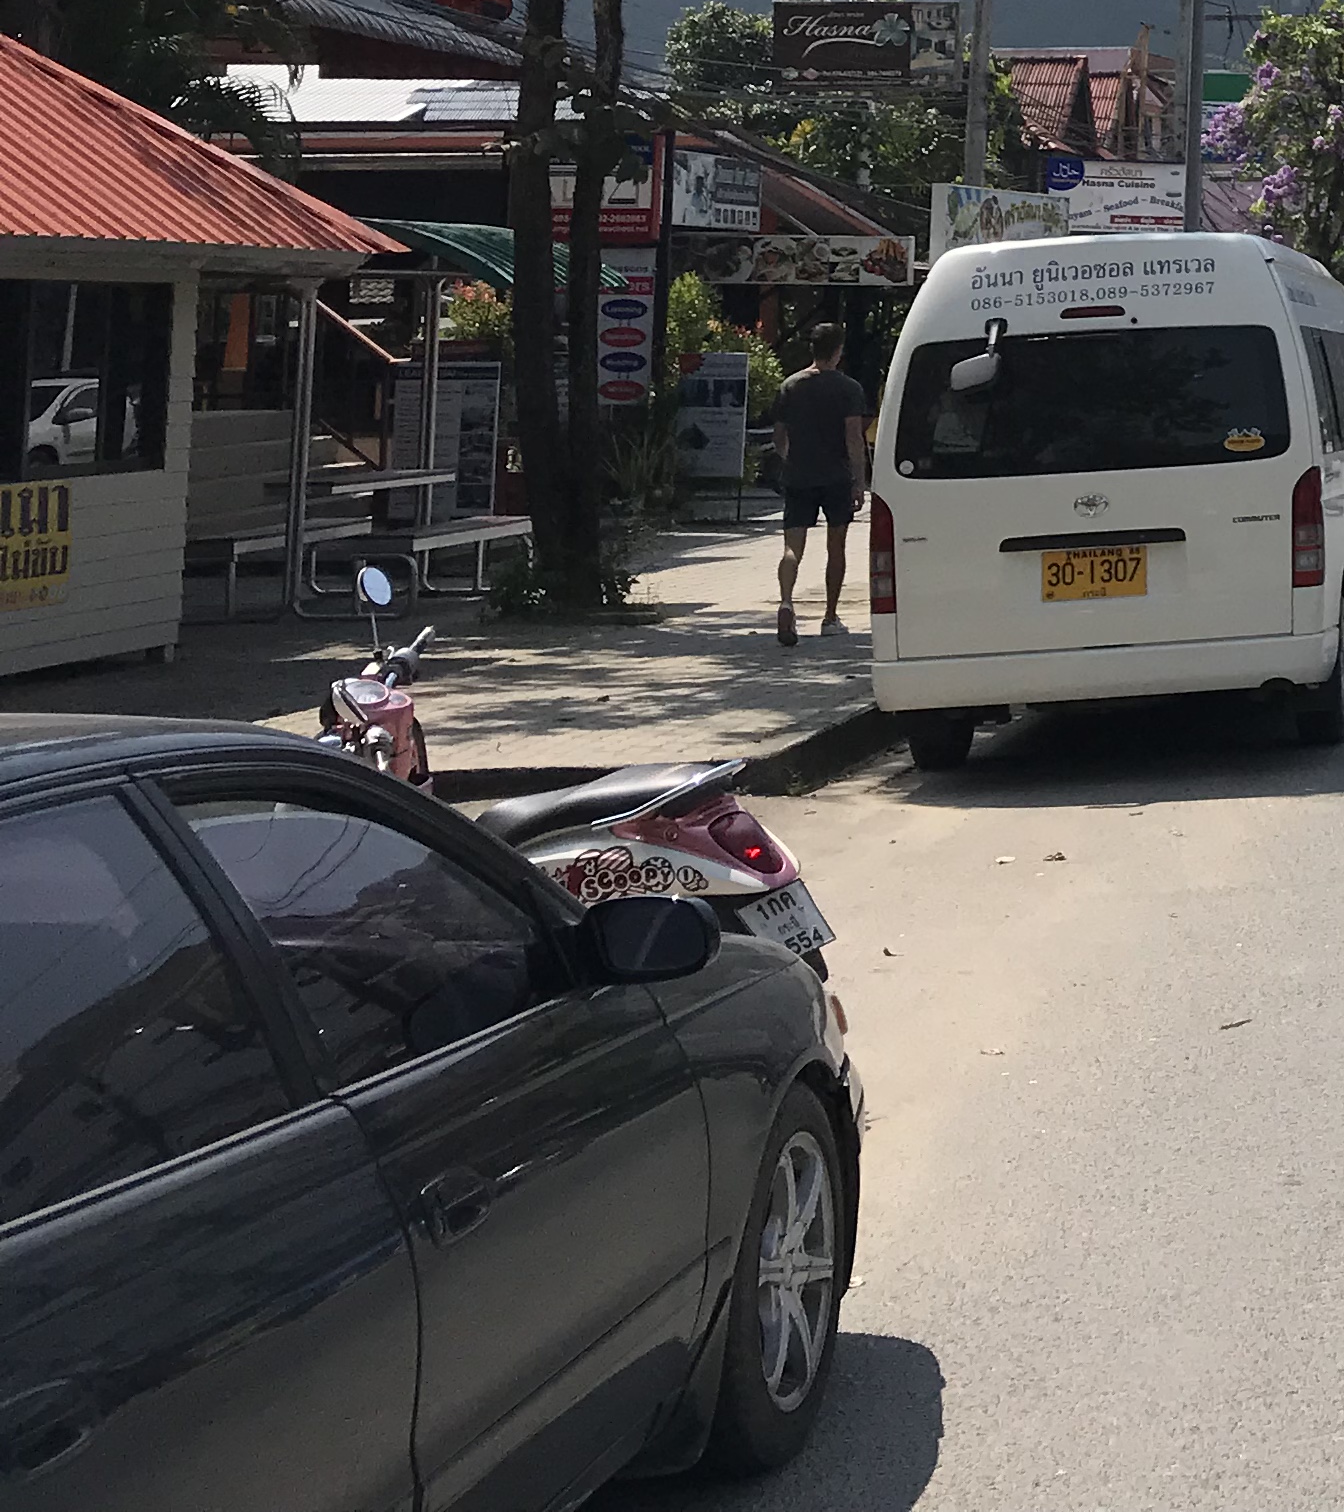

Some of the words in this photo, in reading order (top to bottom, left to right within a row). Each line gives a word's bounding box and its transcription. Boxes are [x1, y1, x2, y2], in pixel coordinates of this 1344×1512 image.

[783, 15, 878, 37] Hasna
[1082, 179, 1115, 188] Hasna
[1118, 179, 1156, 189] Cuisine
[1103, 196, 1139, 212] Seafood
[971, 266, 1023, 291] อันนา
[1143, 257, 1215, 275] แทรเวล
[971, 281, 1215, 311] 086-5153018,089-5372967
[1066, 548, 1123, 561] THAILAND
[1047, 557, 1142, 587] 30-1307
[582, 866, 674, 900] SCOOPY
